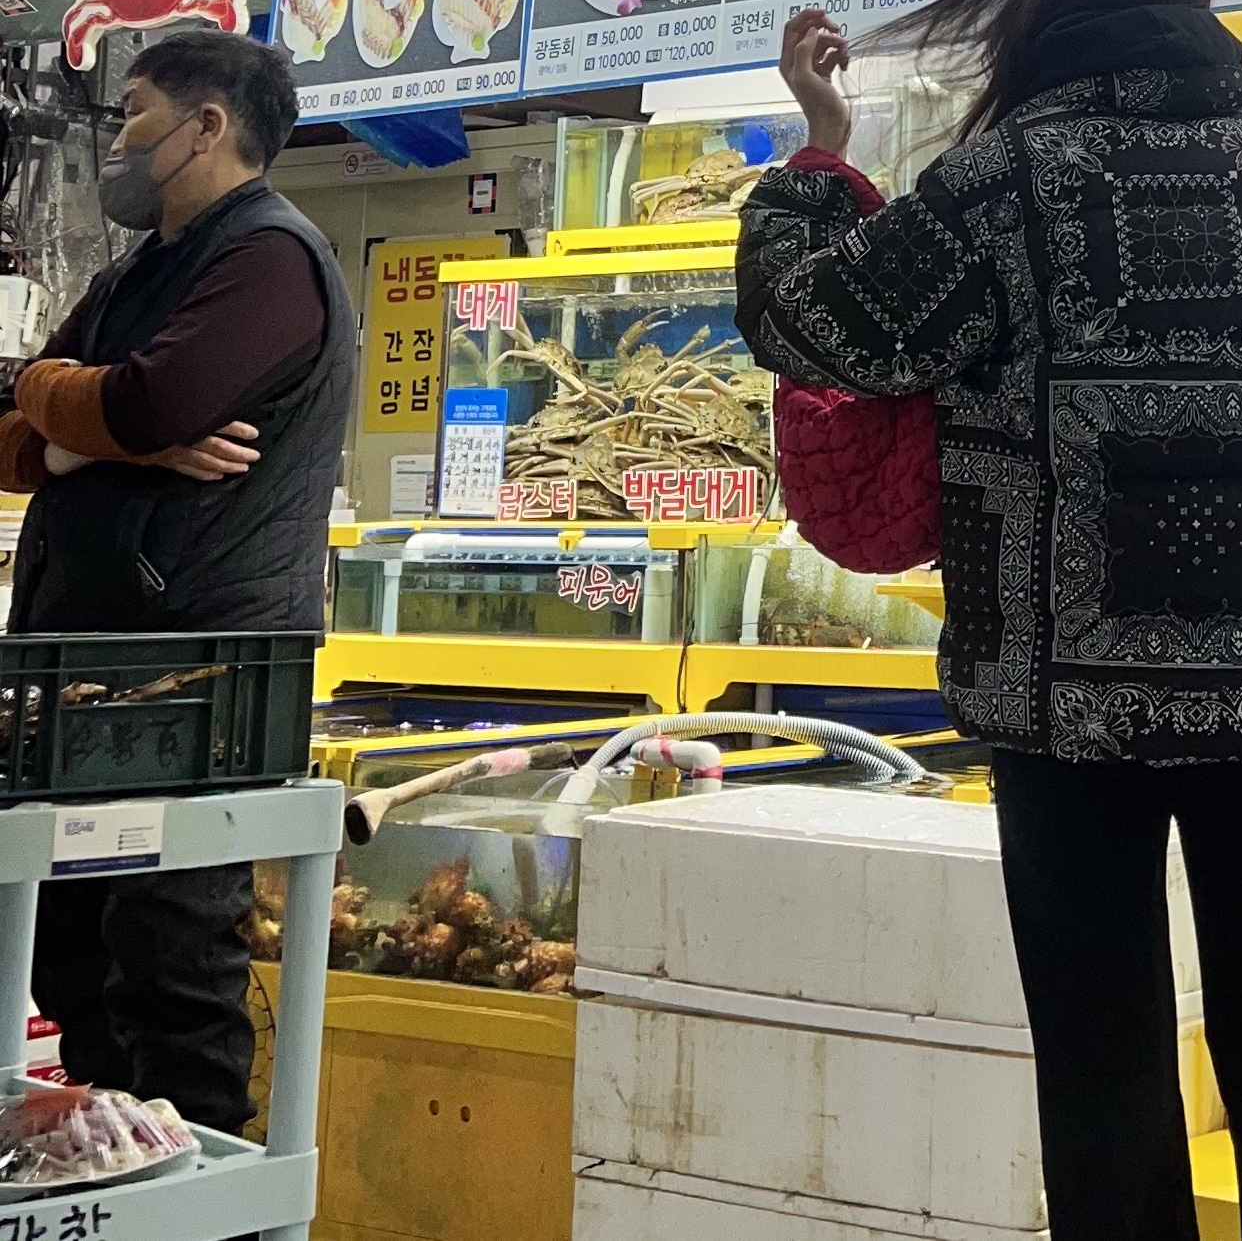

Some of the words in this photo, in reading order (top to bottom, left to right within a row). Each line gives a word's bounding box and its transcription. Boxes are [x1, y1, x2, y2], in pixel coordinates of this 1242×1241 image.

[600, 24, 644, 46] 50,000
[673, 14, 717, 36] 80,000
[730, 9, 775, 35] 광연회
[534, 35, 576, 61] 광돔회
[668, 40, 715, 61] 120,000
[475, 70, 516, 90] 90,000
[456, 281, 519, 331] 대게
[498, 479, 578, 521] 랍스터
[622, 466, 758, 523] 박달대게
[558, 563, 642, 613] 피문어
